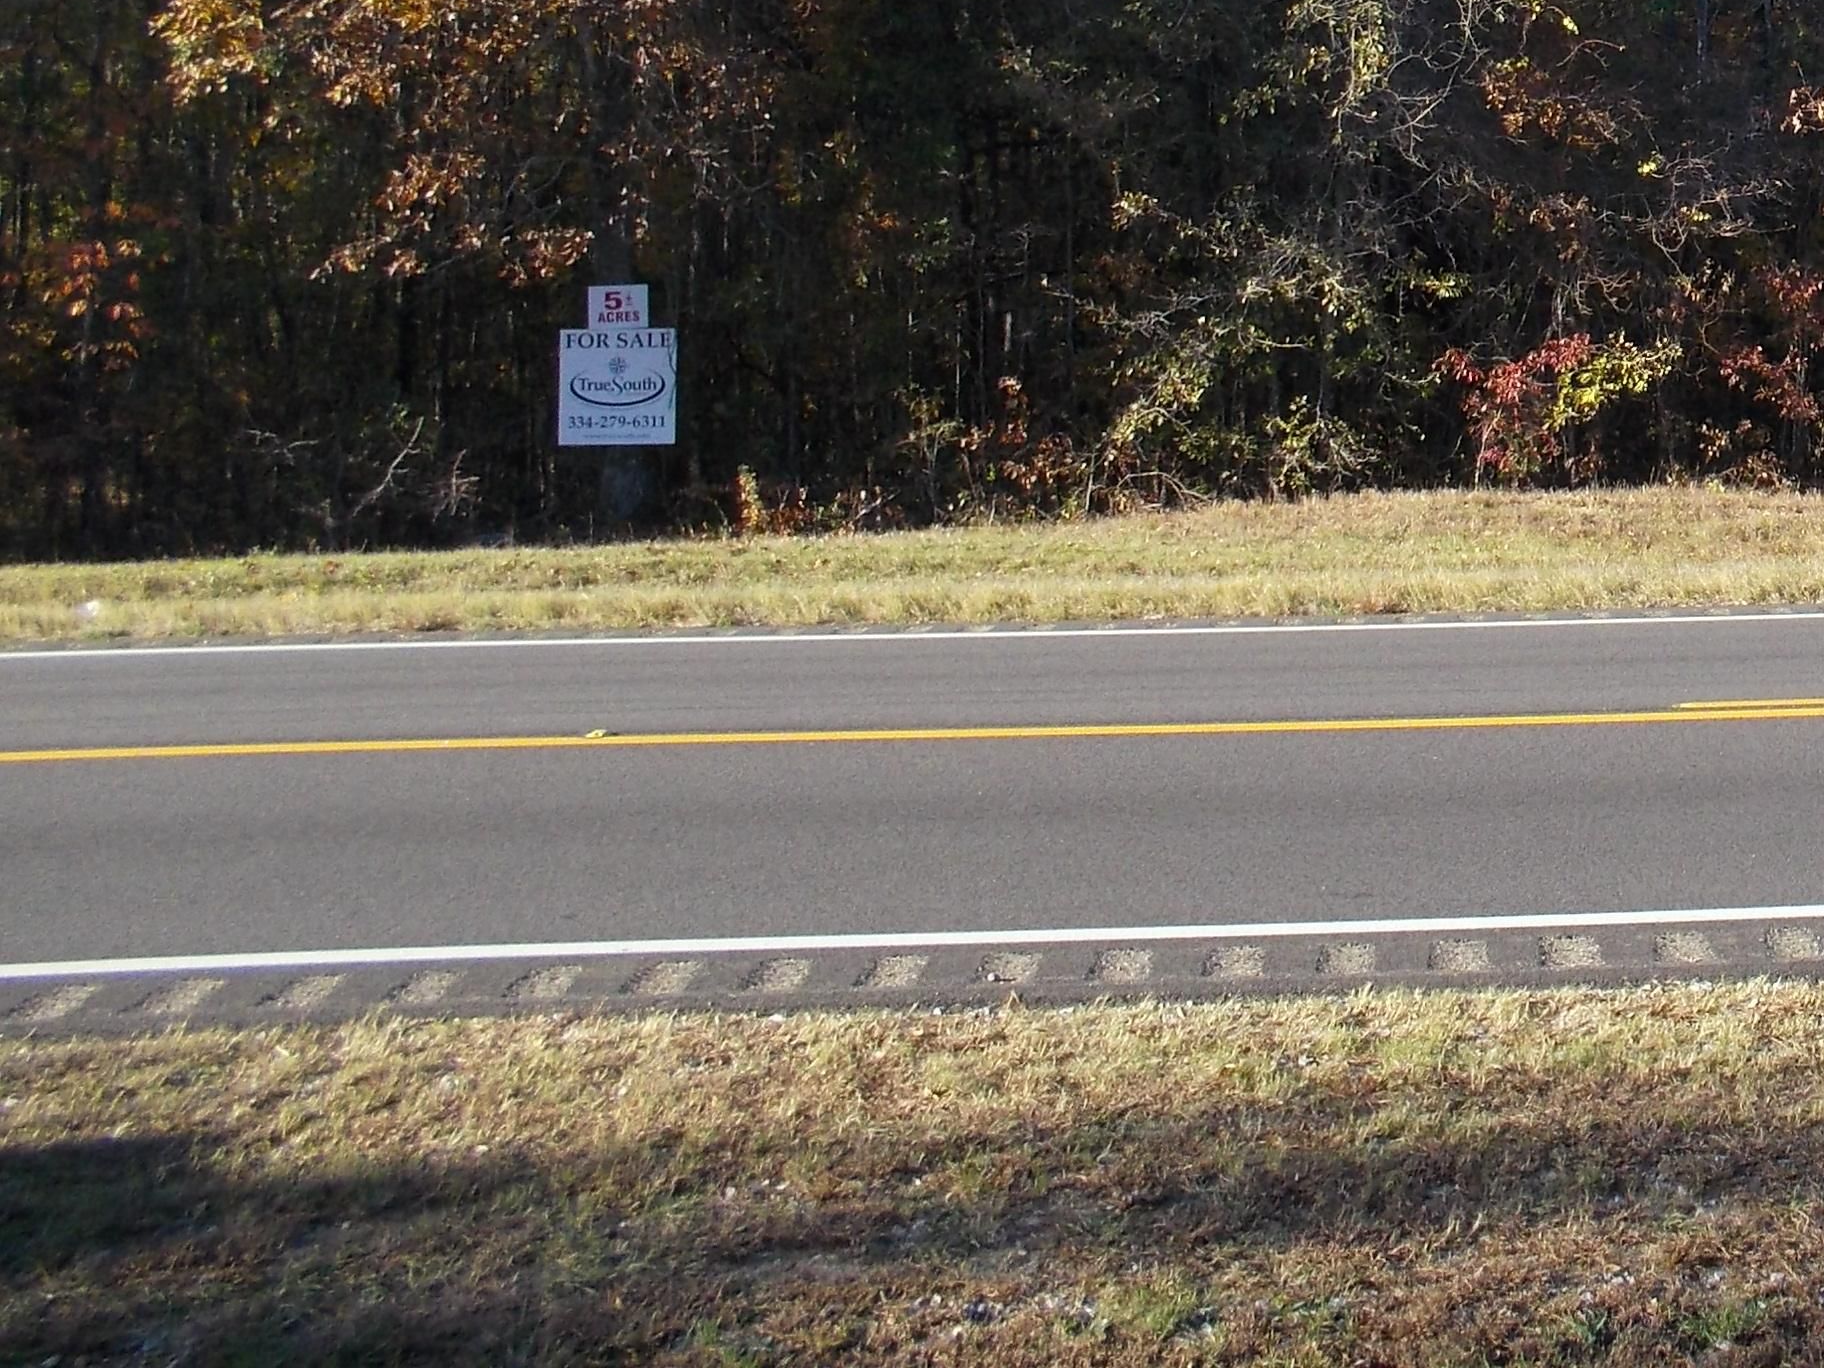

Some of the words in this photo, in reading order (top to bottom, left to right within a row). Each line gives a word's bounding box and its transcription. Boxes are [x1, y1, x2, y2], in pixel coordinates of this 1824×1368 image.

[598, 311, 640, 323] ACRES
[565, 333, 609, 349] FOR
[616, 332, 671, 349] SALE
[578, 376, 657, 396] TrueSouth
[568, 415, 665, 429] 334-279-6311
